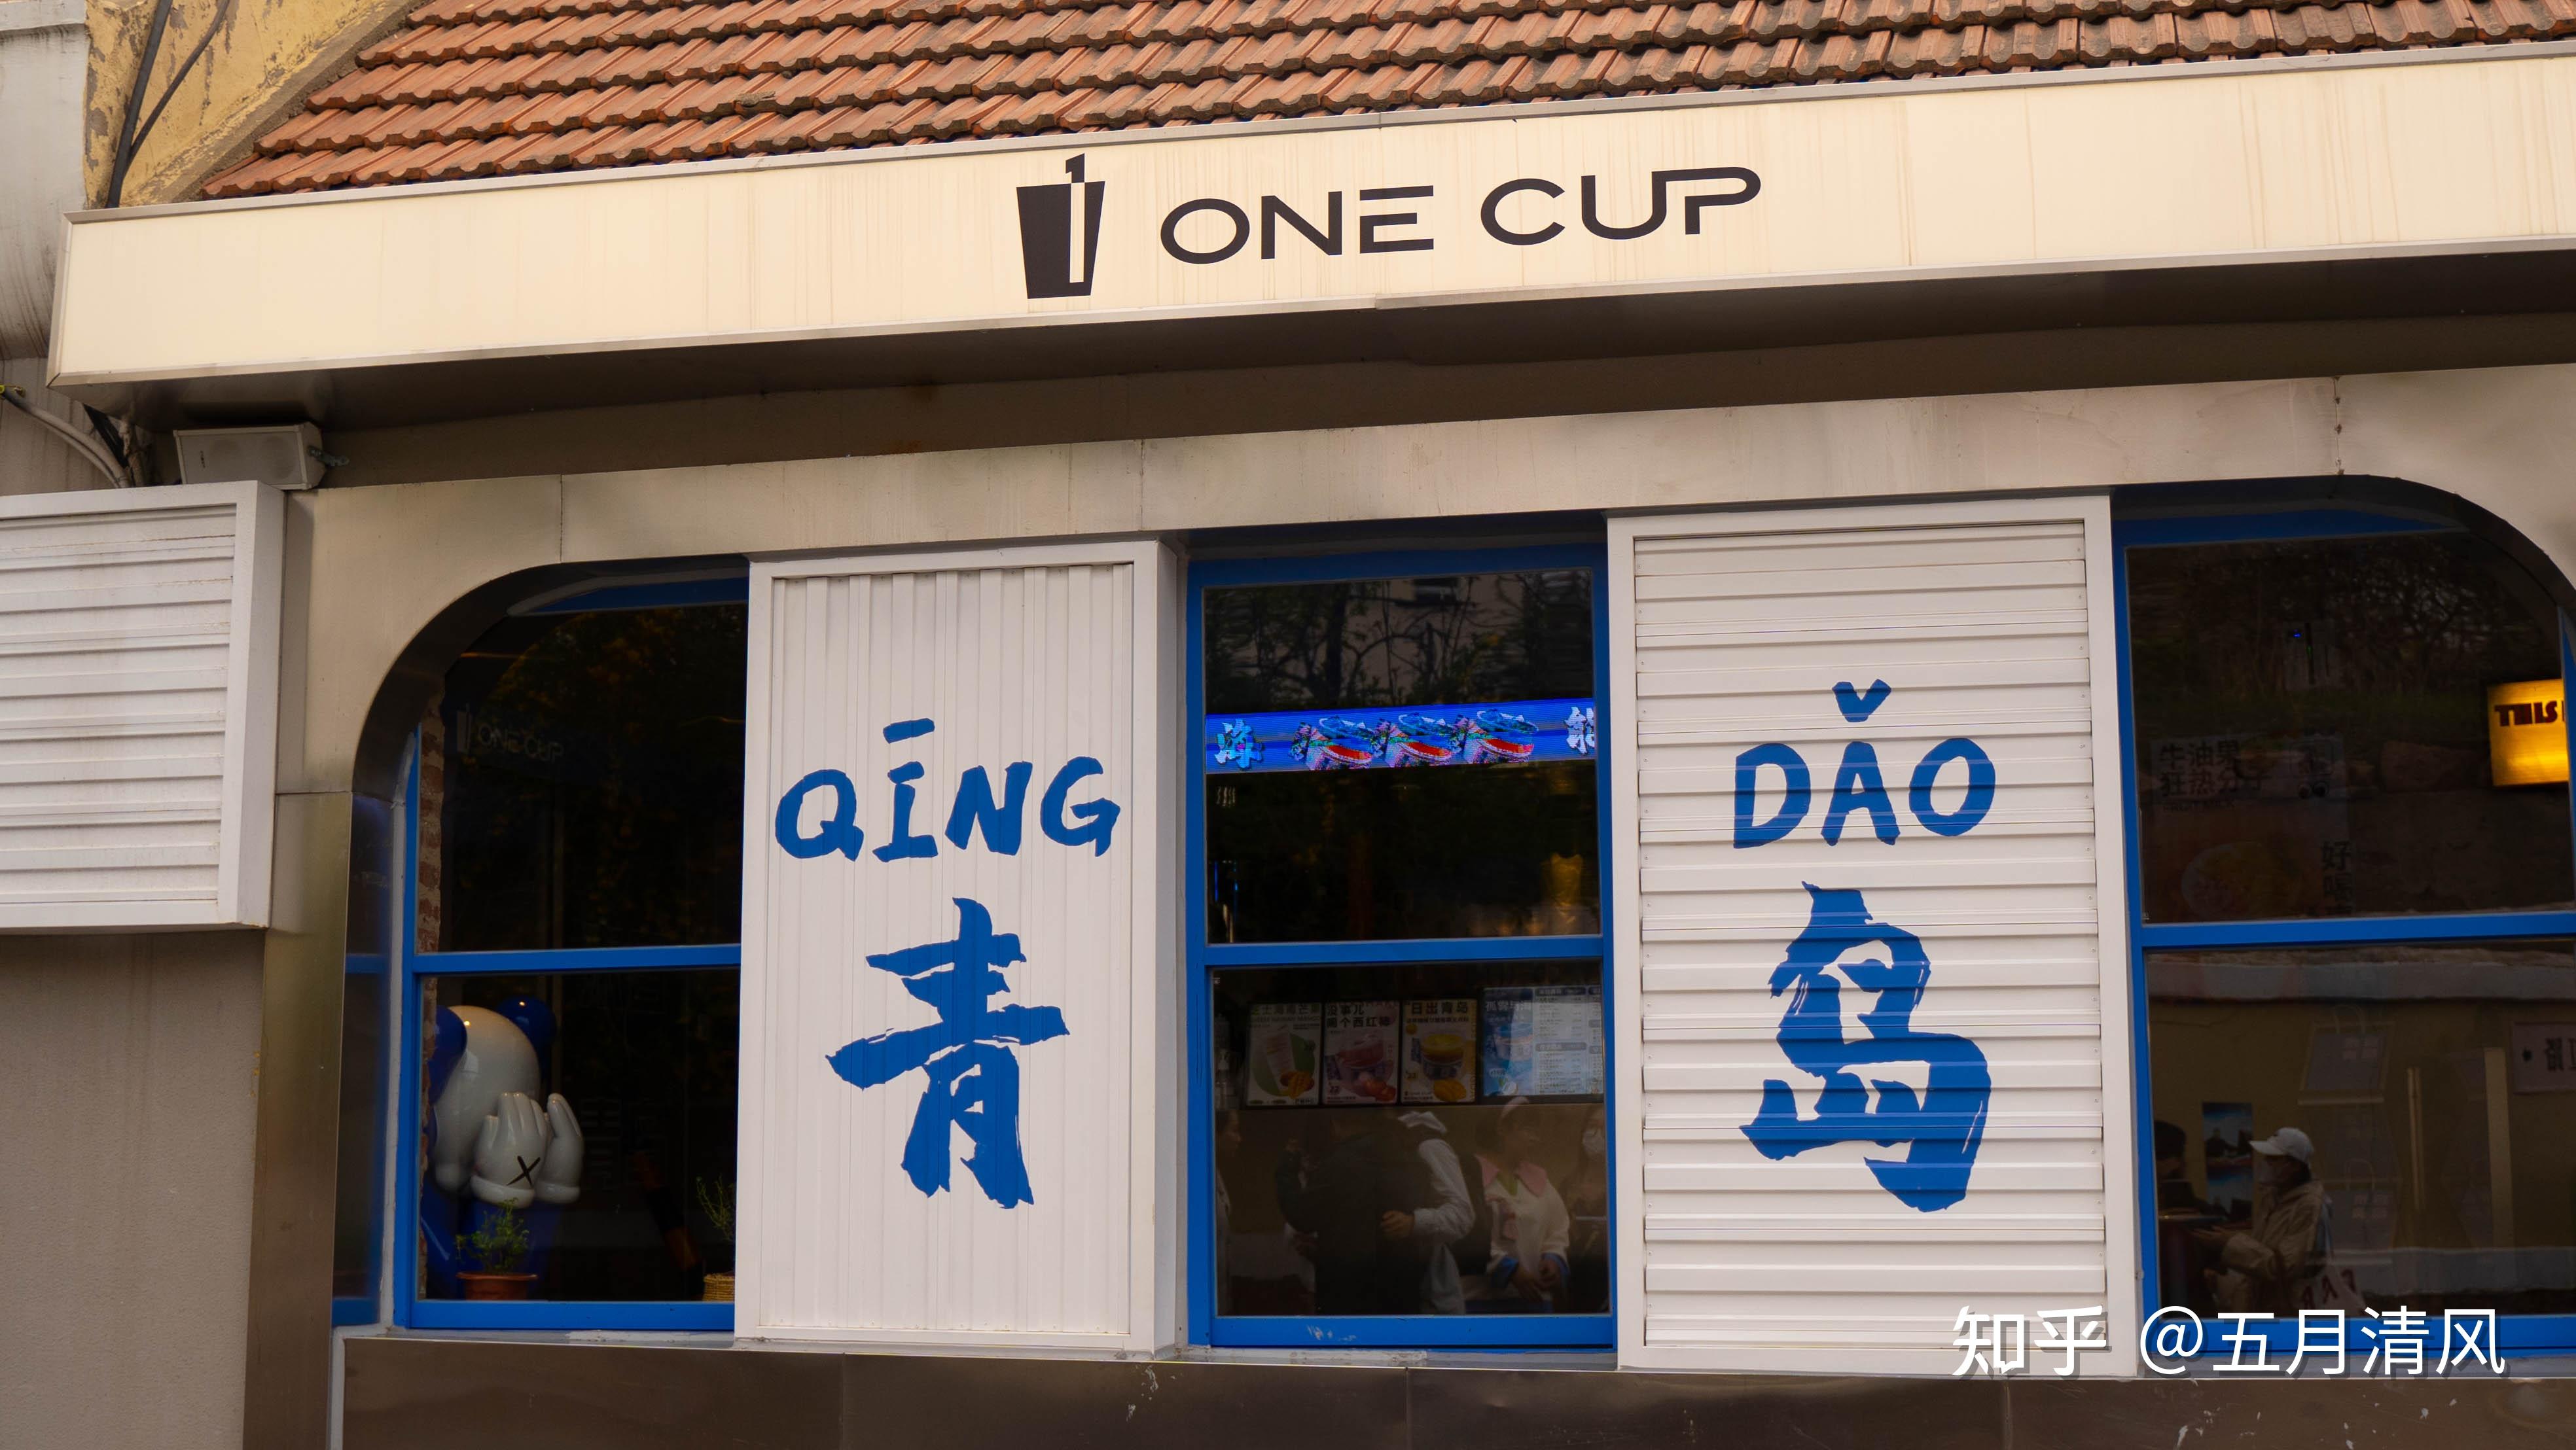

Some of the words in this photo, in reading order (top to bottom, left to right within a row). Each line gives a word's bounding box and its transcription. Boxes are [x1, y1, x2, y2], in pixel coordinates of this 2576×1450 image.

[1160, 185, 1434, 264] ONE
[1480, 166, 1761, 245] CUP
[476, 722, 524, 754] ONE
[524, 736, 565, 764] CUP
[2494, 701, 2558, 726] THIS
[1412, 1000, 1468, 1015] 日出青岛
[829, 898, 1068, 1209] 青
[1742, 883, 1992, 1212] 岛
